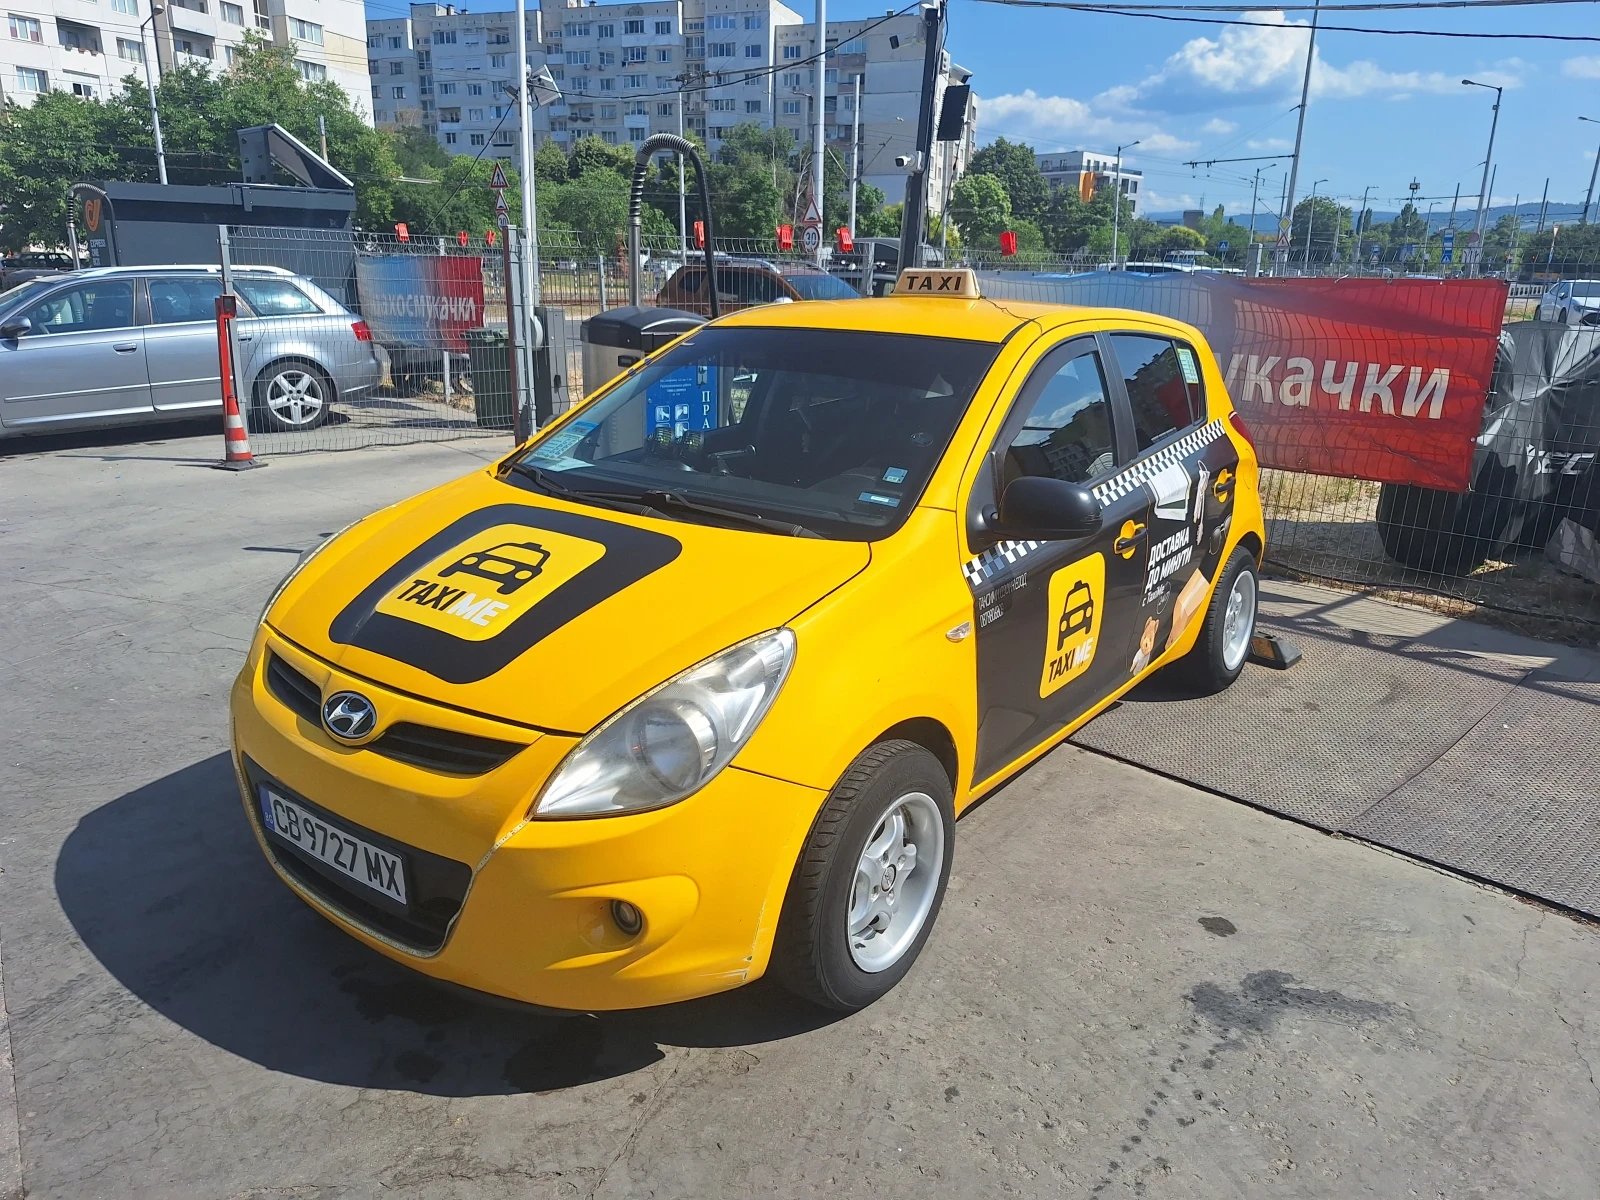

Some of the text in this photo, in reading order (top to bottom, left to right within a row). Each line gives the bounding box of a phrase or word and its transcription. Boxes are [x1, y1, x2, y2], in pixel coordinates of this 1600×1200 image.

[805, 232, 817, 246] 30
[906, 276, 962, 291] TAXI
[1144, 545, 1193, 594] ДО МИНУТИ
[1147, 526, 1190, 571] ДОСТАВКА
[397, 579, 510, 627] TAXIME
[1048, 636, 1094, 684] TAXIME
[264, 811, 274, 825] BG
[303, 817, 358, 873] 9727
[363, 846, 402, 897] MX
